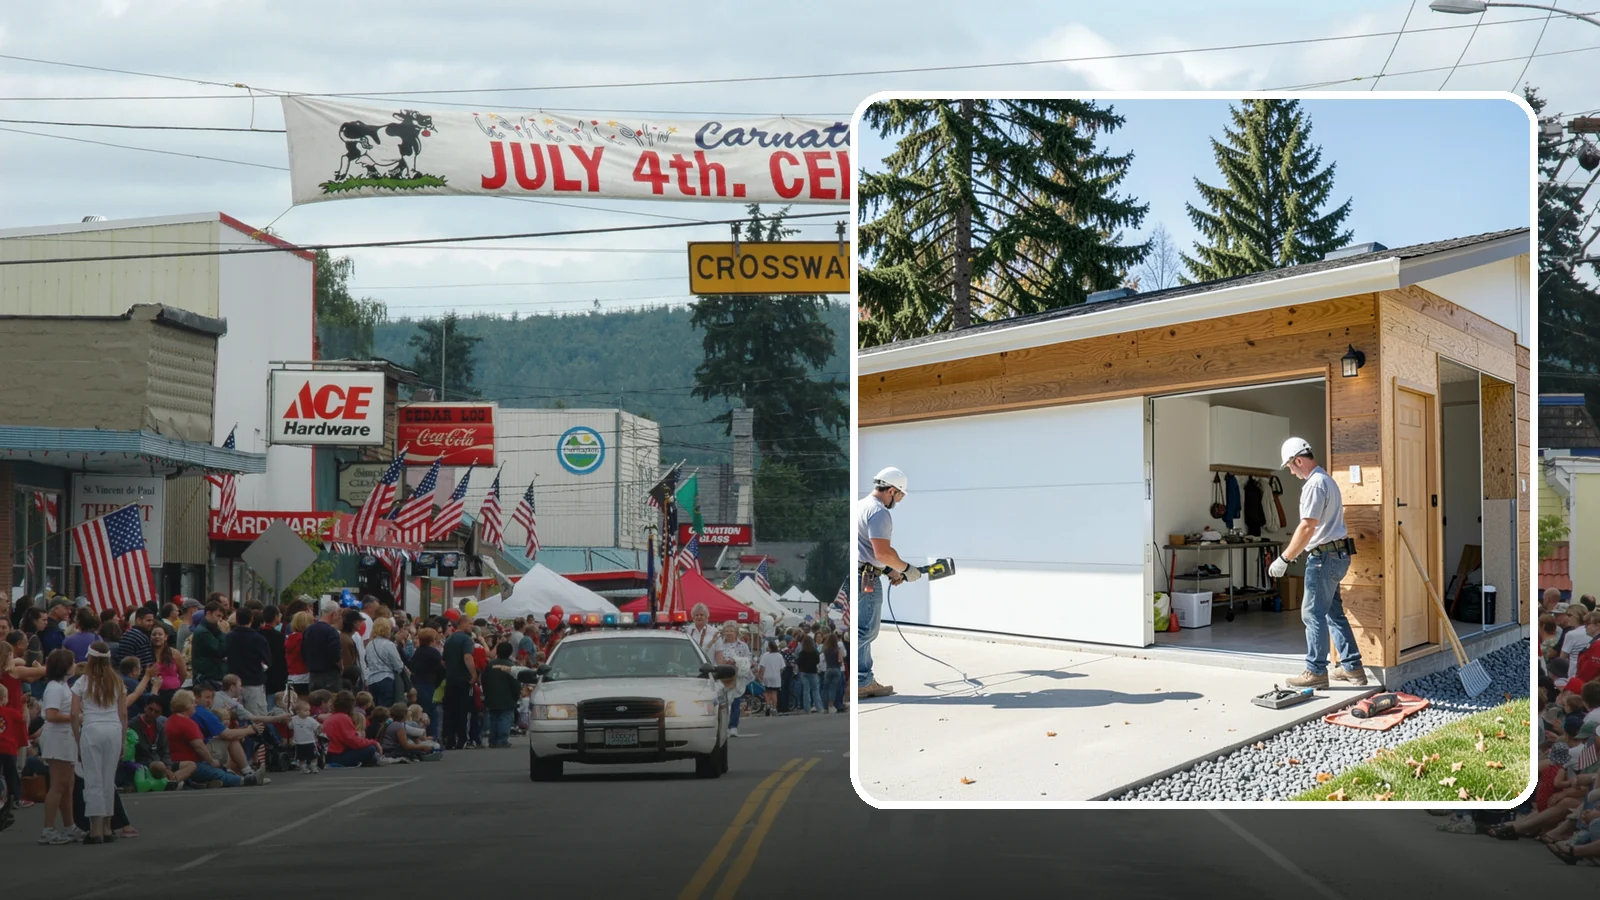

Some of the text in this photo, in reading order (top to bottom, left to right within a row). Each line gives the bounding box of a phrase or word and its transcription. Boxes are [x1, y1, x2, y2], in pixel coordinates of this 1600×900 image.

[481, 141, 604, 192] JULY
[632, 150, 746, 197] 4th.
[697, 254, 850, 280] CROSSWA
[283, 380, 373, 419] ACE
[405, 409, 452, 422] CEDAR
[283, 421, 371, 436] Hardware
[416, 428, 476, 446] Coca-Cola
[353, 467, 385, 480] Simpl
[95, 485, 124, 495] Vincent
[126, 486, 136, 494] de
[138, 486, 155, 495] Paul
[81, 503, 154, 522] THT
[688, 526, 741, 535] CRNATION
[699, 535, 730, 543] GLASS
